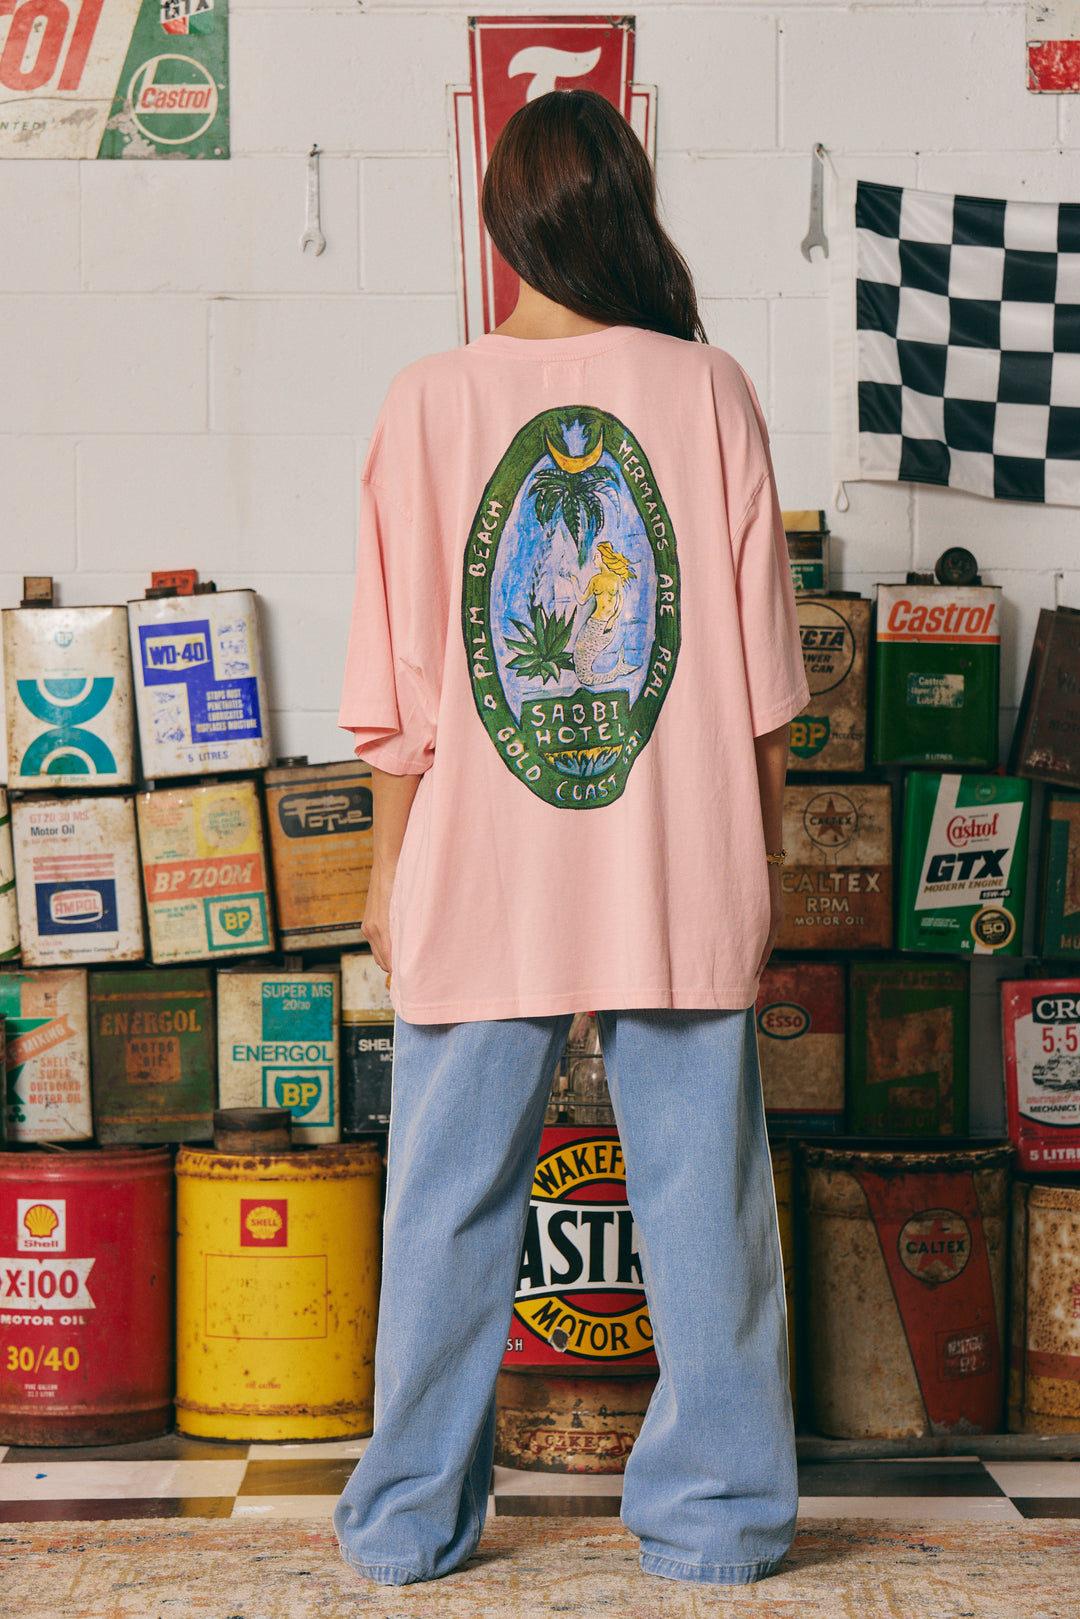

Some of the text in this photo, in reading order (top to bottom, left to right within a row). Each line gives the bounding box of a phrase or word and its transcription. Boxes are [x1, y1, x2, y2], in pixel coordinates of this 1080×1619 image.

[141, 88, 212, 108] Castrol
[619, 439, 669, 551] MERMAIDS
[468, 499, 503, 577] BEACH
[887, 600, 995, 633] Castrol
[469, 606, 494, 680] PALM
[644, 574, 674, 698] ARE REAL
[530, 701, 618, 726] SABBI
[535, 722, 625, 747] HOTEL
[790, 722, 826, 748] BP
[199, 751, 229, 761] LITRES
[497, 726, 541, 781] GOLD
[556, 773, 617, 800] COAST
[810, 816, 852, 826] CALTEX
[30, 824, 75, 836] Motor Oil
[947, 813, 999, 848] Castrol
[927, 848, 1009, 883] GTX
[154, 862, 255, 893] BP ZOOM
[782, 870, 882, 893] CALTEX
[924, 879, 1004, 893] MODERN ENGINE
[55, 898, 100, 915] AMPOL
[806, 897, 850, 913] RPM
[224, 911, 250, 931] BP
[794, 914, 841, 927] MOTOR
[982, 922, 1006, 935] 50
[263, 985, 332, 998] SUPER MS
[100, 1009, 202, 1036] ENERGOL
[766, 1012, 803, 1028] Esso
[131, 1041, 174, 1053] MOTOR
[232, 1045, 334, 1062] ENERGOL
[41, 1056, 70, 1068] SHELL
[40, 1069, 71, 1080] SUPER
[30, 1080, 81, 1092] OUTBOARD
[281, 1083, 318, 1106] BP
[29, 1093, 82, 1105] MOTOR OIL
[1030, 1104, 1077, 1113] MECHANICS
[1030, 1150, 1039, 1161] 5
[251, 1218, 277, 1227] SHELL
[24, 1240, 58, 1248] Shell
[906, 1239, 966, 1254] CALTEX
[0, 1314, 86, 1326] MOTOR OIL
[531, 1300, 630, 1351] MOTOR
[7, 1346, 80, 1374] 30/40
